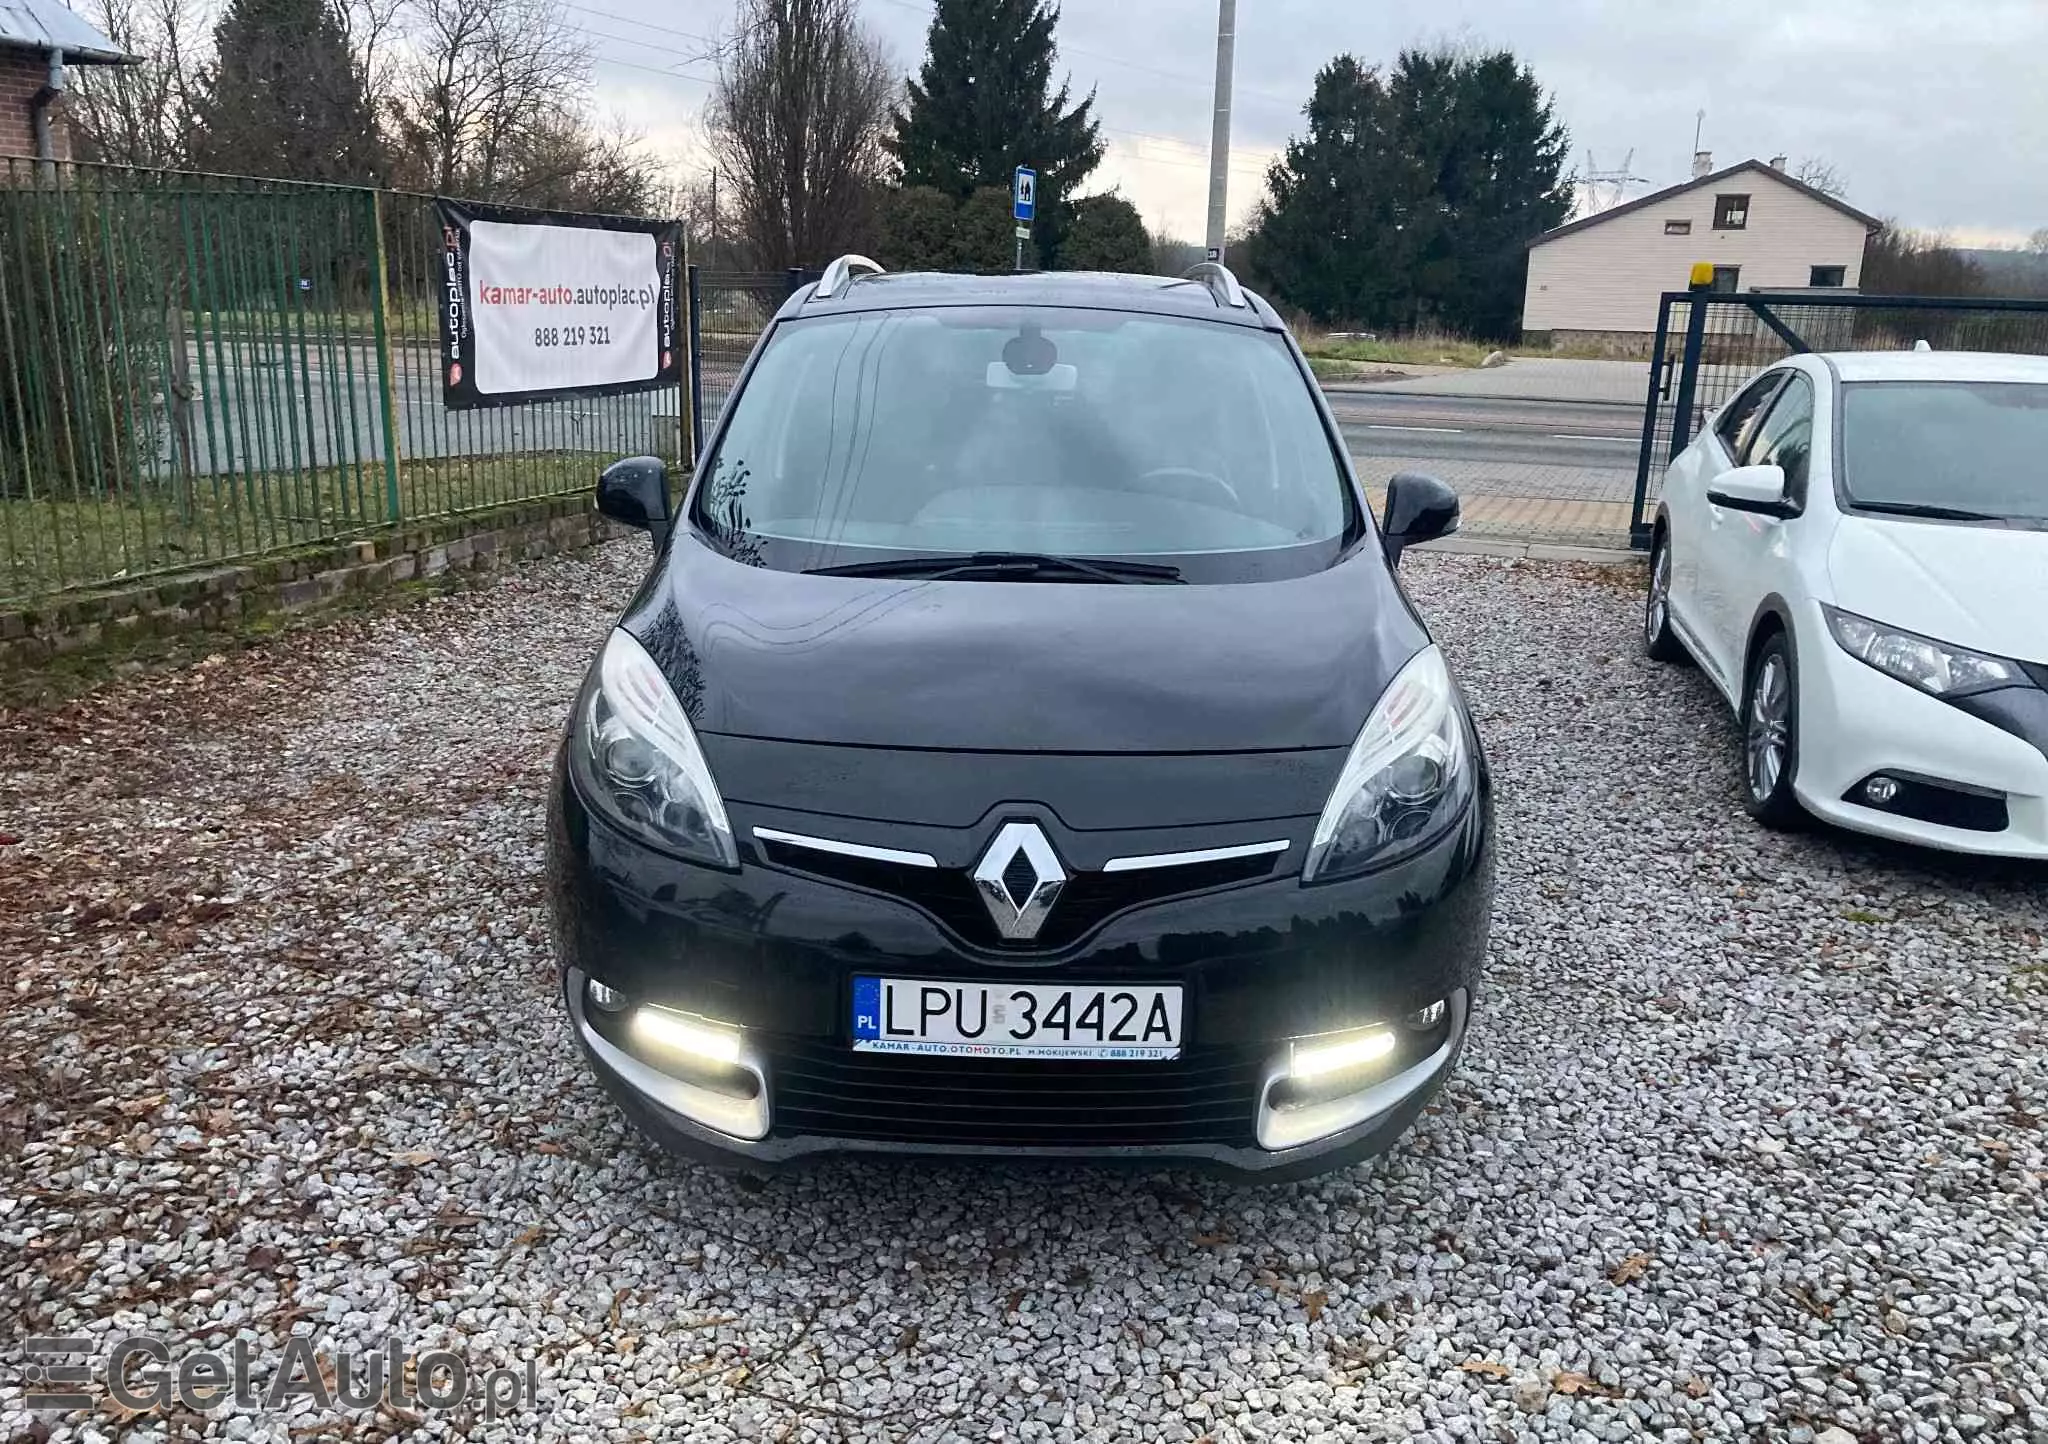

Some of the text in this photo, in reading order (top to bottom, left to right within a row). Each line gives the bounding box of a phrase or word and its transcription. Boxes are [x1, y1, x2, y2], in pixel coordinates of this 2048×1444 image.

[479, 280, 655, 310] kamar-auto.autoplac.pl
[662, 241, 672, 348] autoplacpl
[535, 326, 610, 347] 888 219 321
[857, 1015, 877, 1030] PL
[885, 984, 1173, 1042] LPU 3442A
